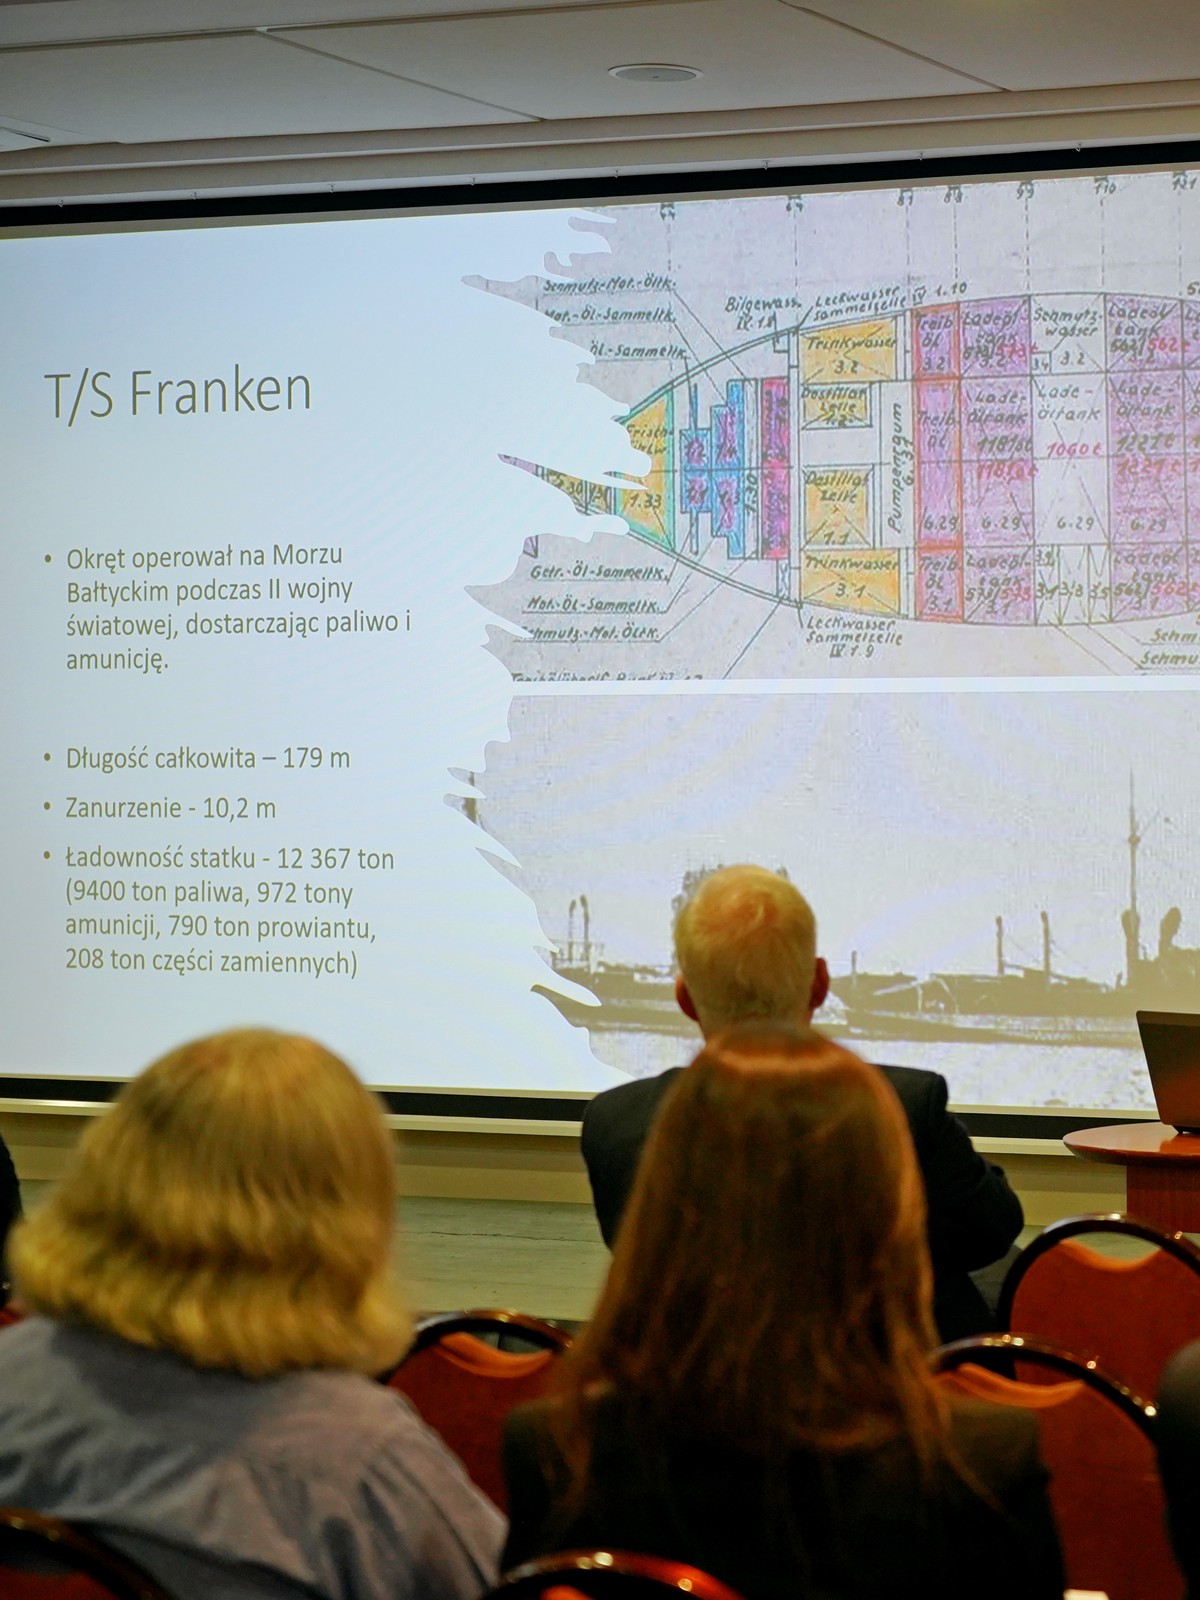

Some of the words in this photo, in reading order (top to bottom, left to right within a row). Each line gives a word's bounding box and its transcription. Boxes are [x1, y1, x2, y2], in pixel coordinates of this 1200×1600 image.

[44, 367, 114, 428] T/S
[131, 363, 312, 416] Franken
[1056, 515, 1095, 532] 6.29
[66, 547, 125, 574] Okręt
[132, 544, 233, 573] operował
[239, 547, 265, 567] na
[272, 544, 343, 566] Morzu
[67, 580, 169, 608] Bałtyckim
[176, 578, 262, 606] podczas
[268, 578, 281, 600] II
[287, 577, 353, 603] wojny
[66, 612, 179, 640] światowej,
[185, 612, 319, 639] dostarczając
[326, 610, 399, 638] paliwo
[405, 609, 412, 632] i
[66, 647, 169, 674] amunicję.
[66, 746, 149, 775] Długość
[155, 745, 256, 770] całkowita
[282, 746, 323, 769] 179
[330, 751, 351, 769] m
[66, 796, 183, 820] Zanurzenie
[203, 797, 249, 824] 10,2
[256, 802, 277, 819] m
[65, 844, 184, 869] Ładowność
[190, 846, 256, 869] statku
[277, 847, 303, 870] 12
[310, 847, 351, 870] 367
[358, 850, 395, 870] ton
[66, 877, 126, 907] (9400
[131, 881, 167, 902] ton
[174, 878, 250, 908] paliwa,
[257, 882, 298, 904] 972
[304, 883, 354, 909] tony
[65, 913, 162, 941] amunicji,
[168, 914, 208, 937] 790
[214, 916, 250, 937] ton
[257, 915, 377, 944] prowiantu,
[65, 947, 104, 970] 208
[110, 950, 146, 970] ton
[152, 948, 214, 977] części
[220, 950, 358, 979] zamiennych)
